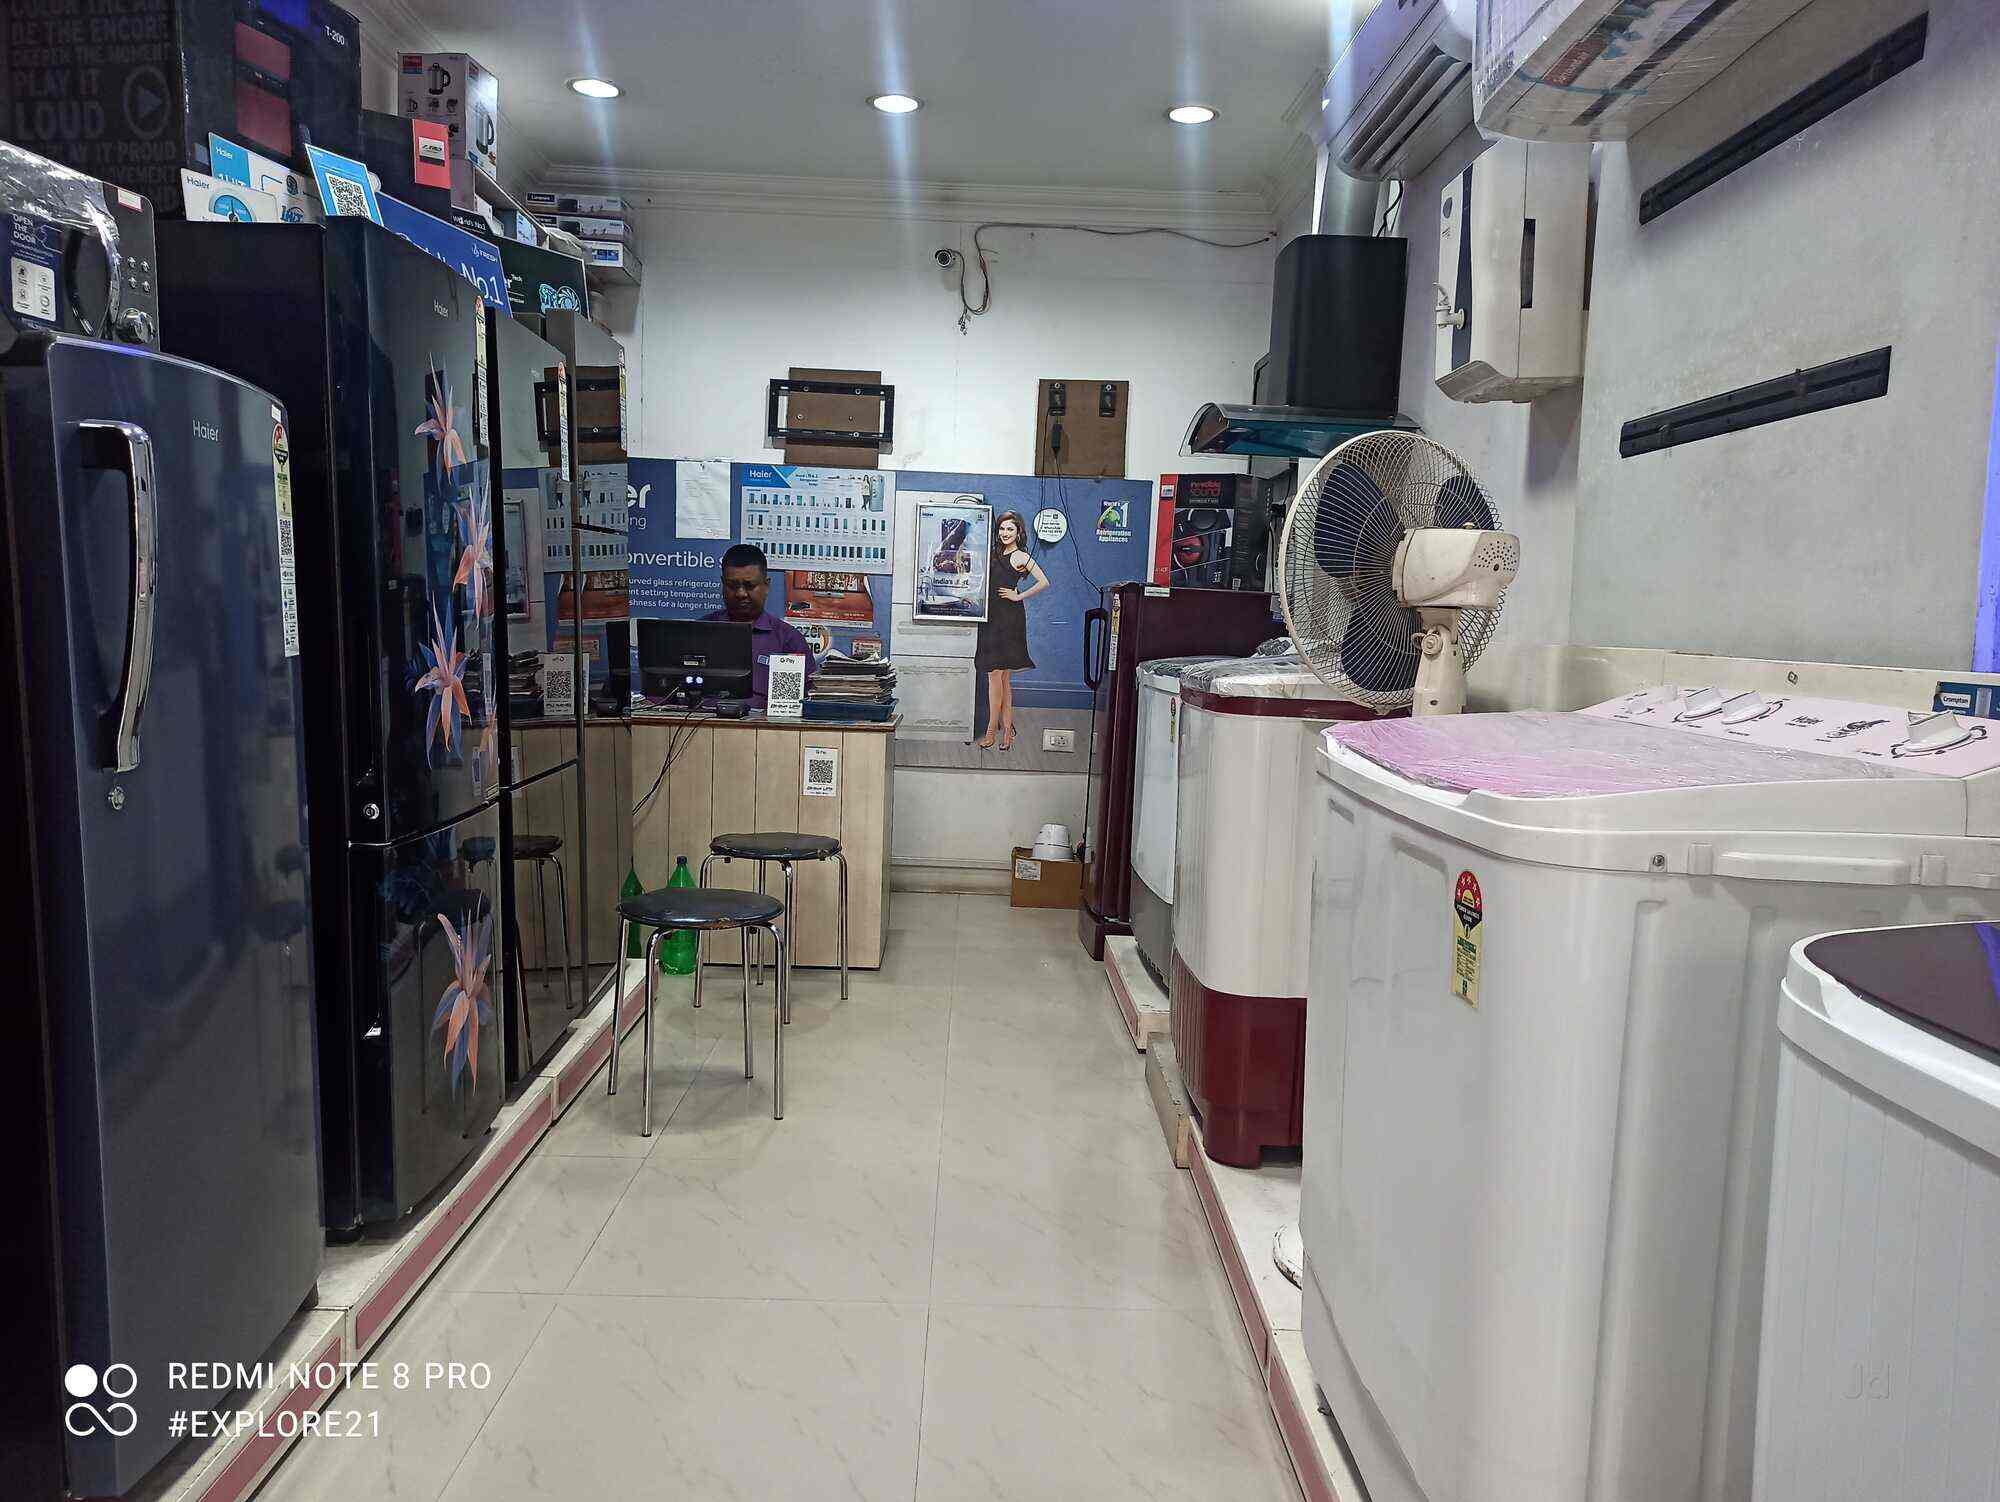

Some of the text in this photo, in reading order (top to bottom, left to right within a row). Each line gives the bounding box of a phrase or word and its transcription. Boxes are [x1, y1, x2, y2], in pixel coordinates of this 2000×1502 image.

[45, 17, 86, 45] THE
[324, 24, 345, 46] T-200
[13, 66, 103, 98] PLAY IT
[15, 100, 105, 141] LOUD
[96, 141, 114, 164] IT
[117, 140, 178, 163] PROUD
[215, 145, 234, 160] Haier
[186, 174, 211, 190] Haier
[13, 223, 29, 233] THE
[13, 230, 37, 244] DOOR
[433, 298, 449, 319] Haier
[192, 419, 220, 443] Haier
[749, 469, 773, 479] Haier
[1120, 500, 1130, 528] 1
[1095, 528, 1133, 538] Refrigeration
[1097, 535, 1129, 544] Appliances
[627, 550, 715, 569] onvertible
[653, 577, 674, 588] glass
[674, 578, 721, 590] refrigerator
[640, 588, 669, 599] setting
[670, 589, 721, 602] temperature
[628, 597, 657, 608] shness
[658, 599, 670, 609] for
[676, 599, 703, 611] longer
[703, 602, 723, 611] time
[786, 657, 796, 666] Pay
[1942, 695, 1969, 705] Crompton
